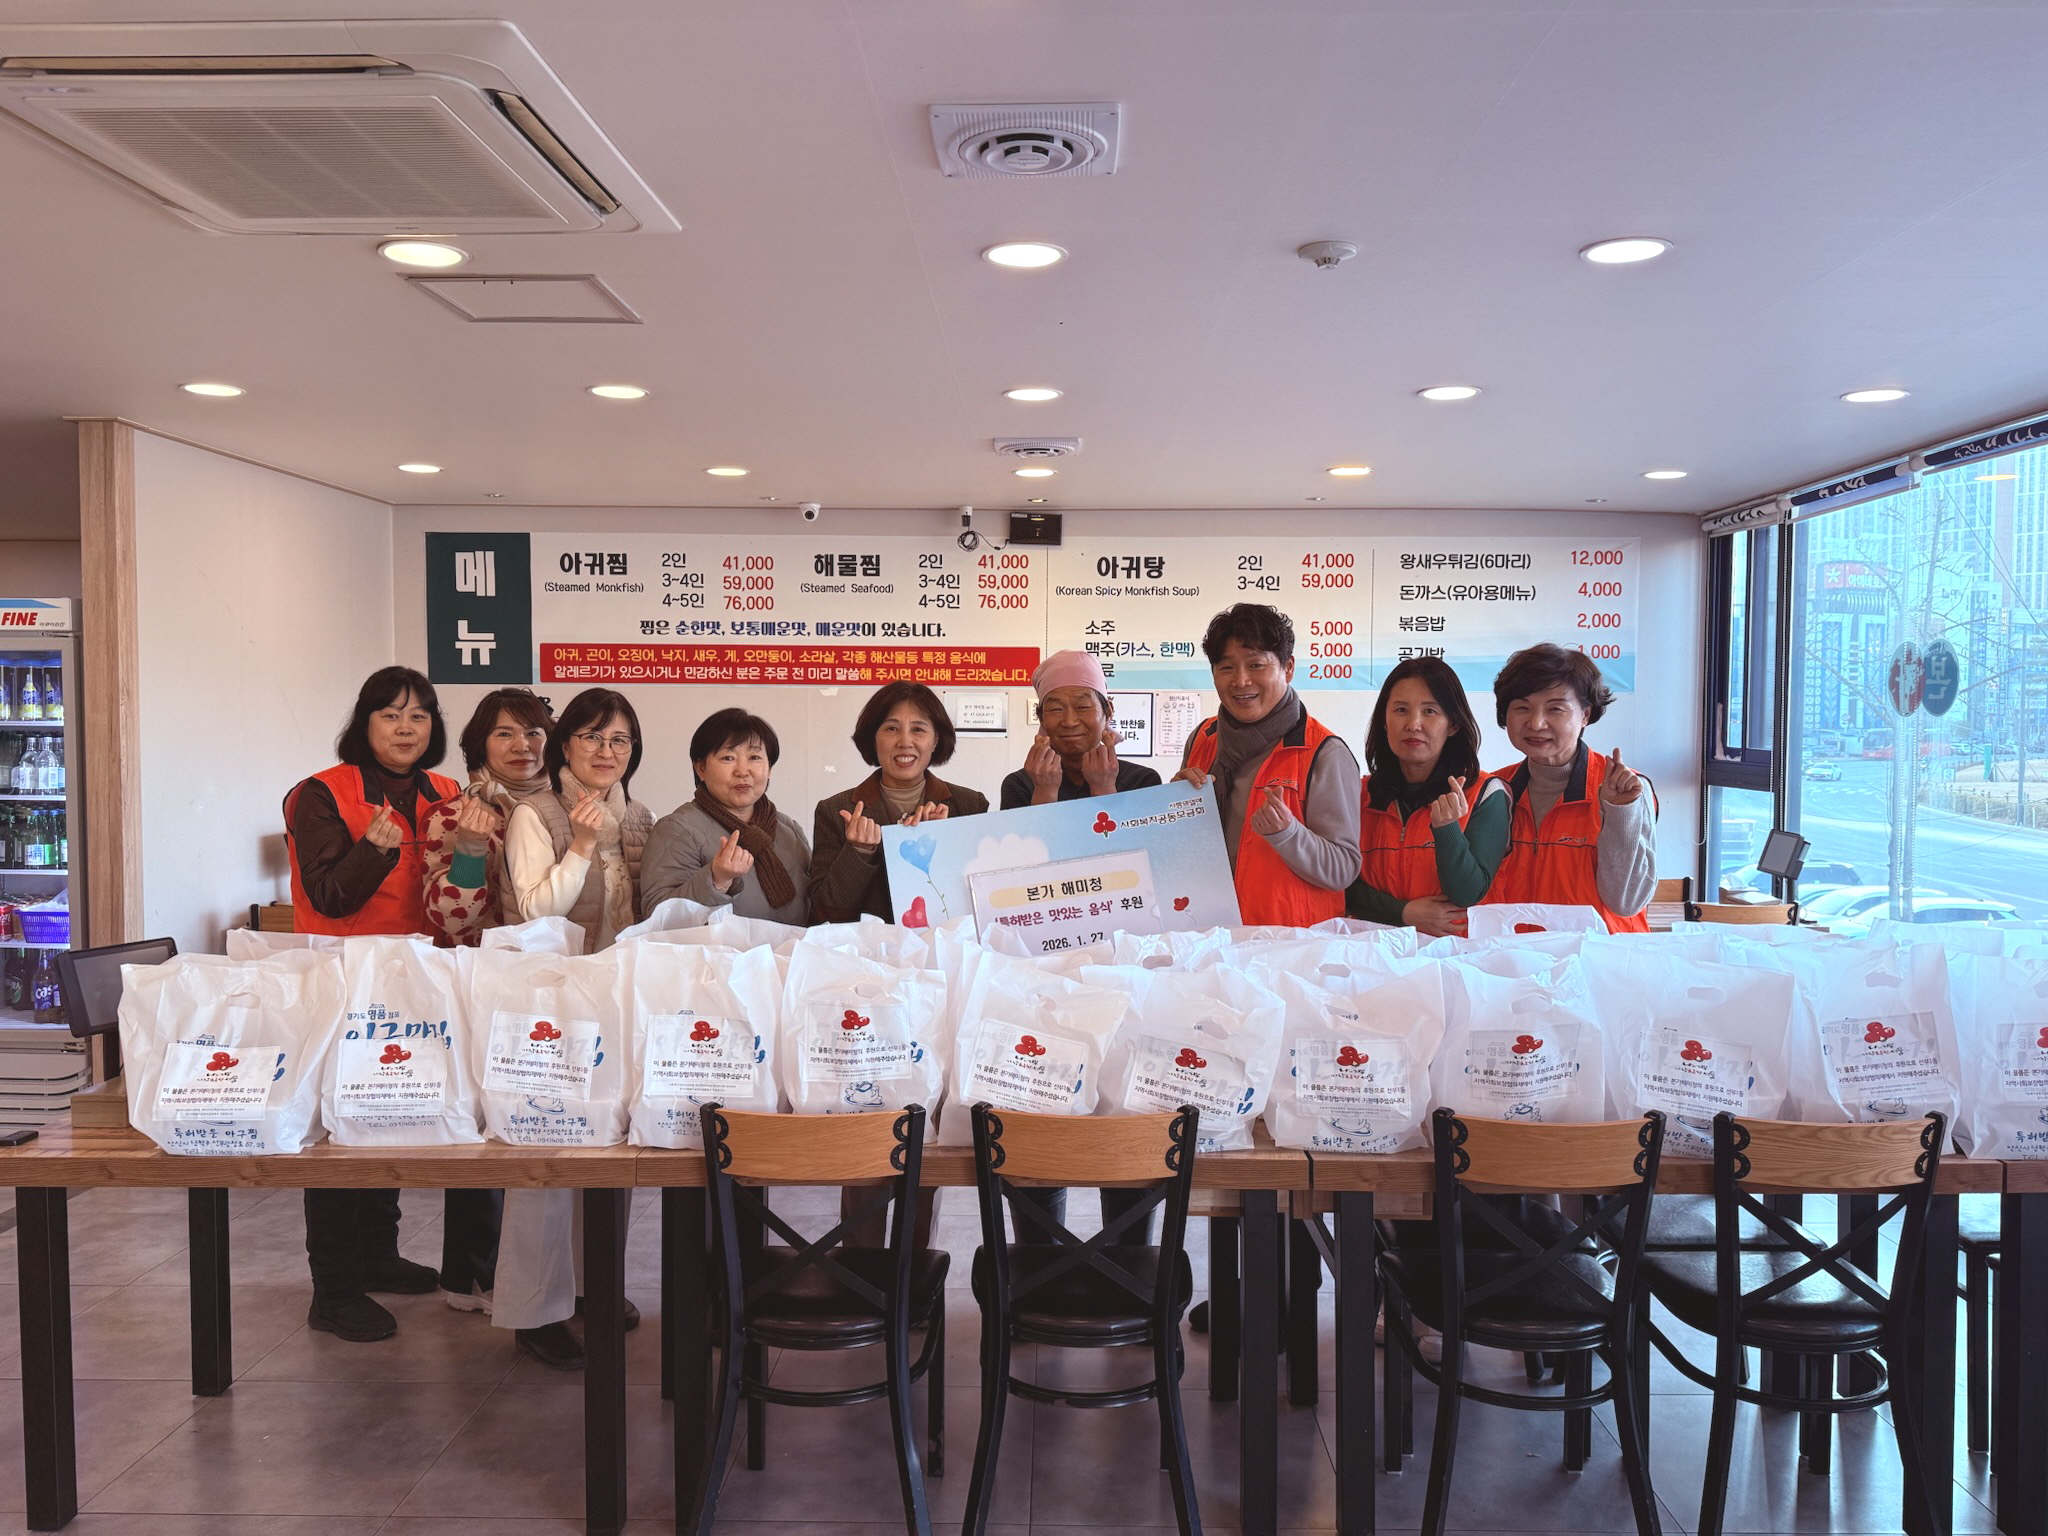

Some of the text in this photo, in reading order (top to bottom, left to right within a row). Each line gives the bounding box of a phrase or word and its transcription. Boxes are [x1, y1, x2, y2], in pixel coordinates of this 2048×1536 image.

[560, 553, 627, 575] 아귀찜
[662, 553, 773, 571] 2인 41,000
[815, 554, 880, 578] 해물찜
[919, 554, 1028, 570] 2인 41,000
[1097, 557, 1165, 578] 아귀탕
[1238, 554, 1354, 570] 2인 41,000
[1401, 551, 1623, 569] 왕새우튀김(6마리) 12,000
[545, 582, 643, 592] (Steamed Monkfish)
[663, 573, 773, 591] 3~4인 59,000
[801, 583, 893, 593] (Steamed Seafood)
[919, 574, 1028, 590] 3~4인 59,000
[1238, 574, 1353, 590] 3~4인 59,000
[1056, 586, 1199, 596] (Korean Spicy Monkfish Soup)
[1400, 582, 1622, 600] 돈까스(유아용메뉴) 4,000
[455, 551, 496, 665] 메뉴
[663, 594, 773, 611] 4~5인 76,000
[919, 594, 1028, 609] 4~5인 76,000
[1, 613, 38, 625] FINE
[1399, 614, 1621, 631] 볶음밥 2,000
[640, 621, 945, 637] 찜은 순한맛, 보통매운맛, 매운맛이 있습니다.
[1086, 621, 1352, 636] 소주 5,000
[554, 649, 985, 665] 아귀, 곤이, 오징어, 낙지, 새우, 게, 오만둥이, 소라살, 각종 해산물등 특정 음식에
[1086, 642, 1352, 658] 맥주(카스, 한맥) 5,000
[1577, 644, 1621, 659] 1000
[554, 666, 1030, 682] 알레르기가 있으시거나 민감하신 분은 주문 전 미리 말씀해 주시면 안내해 드리겠습니다.
[1310, 665, 1352, 679] 2,000
[1120, 720, 1145, 729] 반찬을
[1120, 806, 1205, 828] 사회복지공동모금회
[1027, 877, 1102, 901] 본가 해미청
[1049, 906, 1083, 922] 맛있는
[1120, 896, 1144, 910] 후원
[1042, 938, 1071, 951] 2026.
[1077, 936, 1086, 946] 1.
[368, 1009, 386, 1020] 명품
[510, 1115, 549, 1127] 특허받은
[667, 1109, 701, 1120] 특허받
[174, 1128, 219, 1138] 특허받은
[1312, 1136, 1354, 1148] 특허받은
